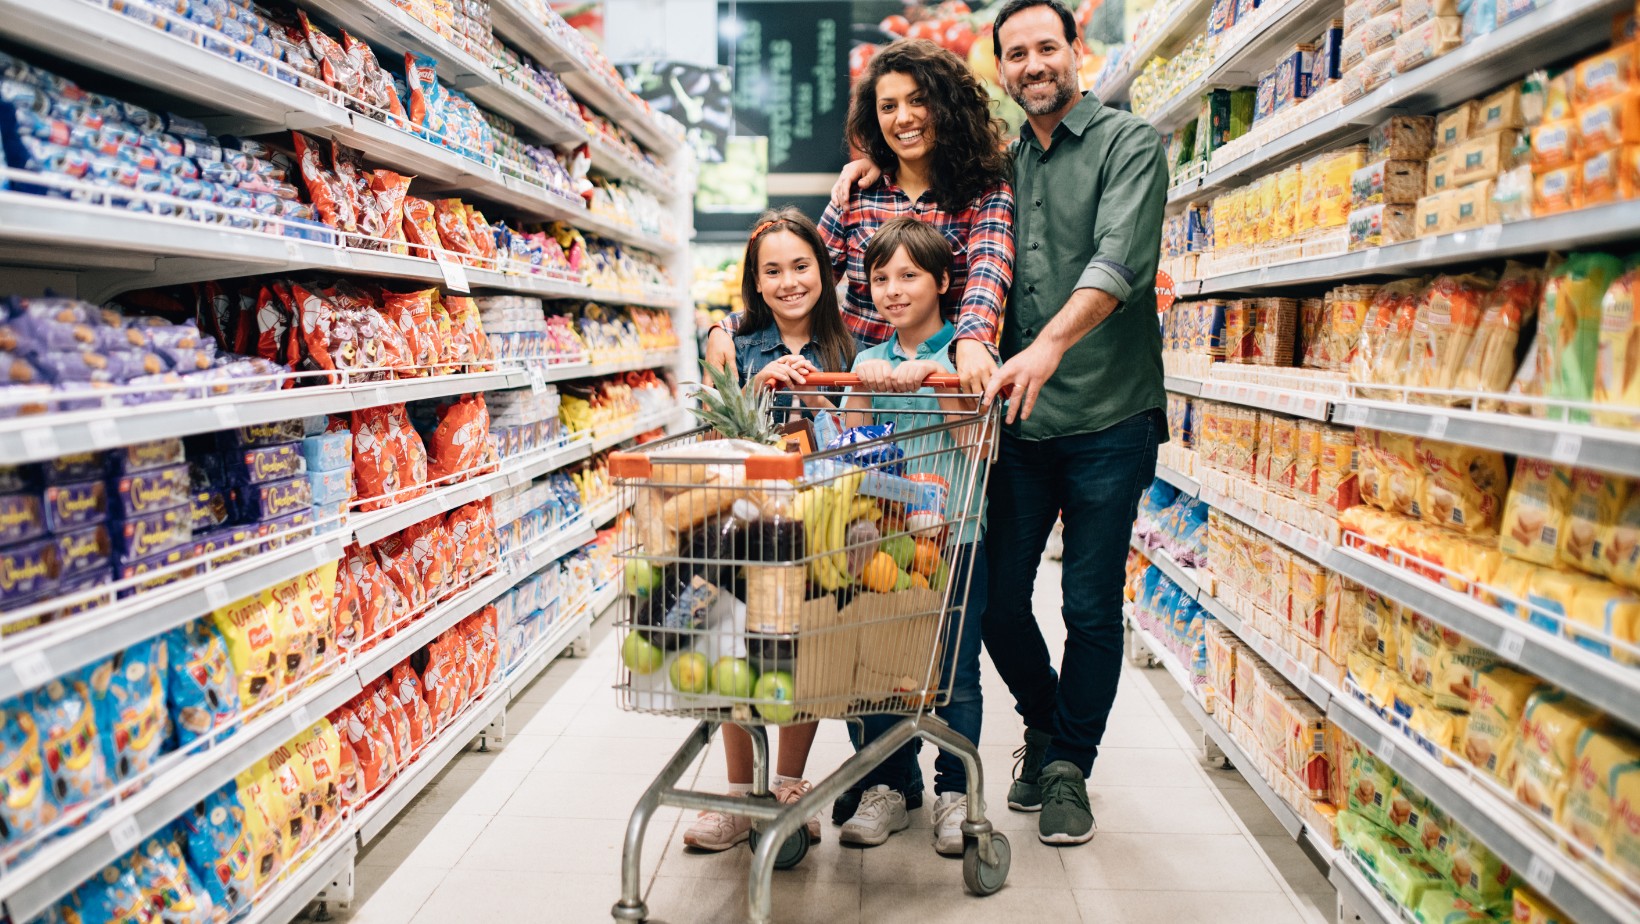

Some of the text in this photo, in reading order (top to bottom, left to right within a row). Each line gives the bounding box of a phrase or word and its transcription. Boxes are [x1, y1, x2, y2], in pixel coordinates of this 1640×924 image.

[733, 20, 762, 109] frutas
[761, 39, 792, 167] verduras
[793, 82, 813, 139] frutas
[811, 18, 836, 114] verduras
